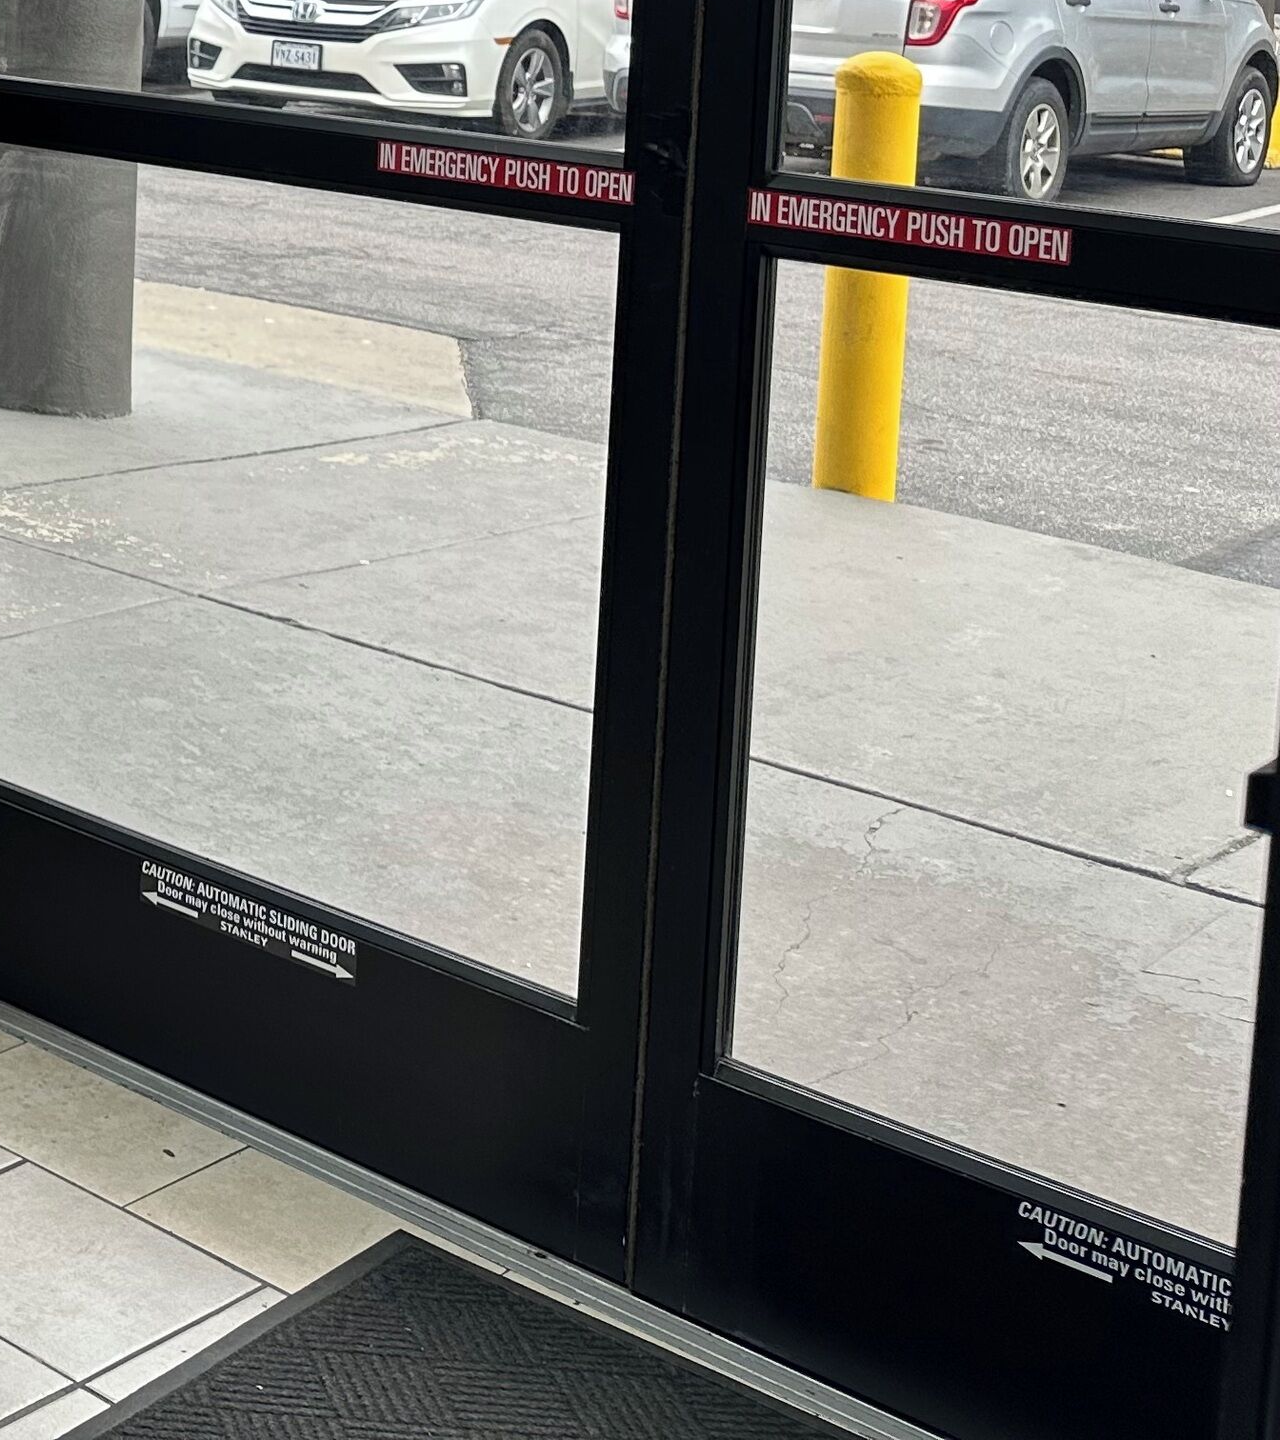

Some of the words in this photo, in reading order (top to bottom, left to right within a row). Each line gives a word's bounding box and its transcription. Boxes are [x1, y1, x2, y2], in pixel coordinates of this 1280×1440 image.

[379, 143, 397, 170] IN
[401, 147, 500, 183] EMERGENCY
[504, 160, 551, 192] PUSH
[557, 166, 580, 196] TO
[584, 170, 633, 203] OPEN
[750, 191, 772, 221] IN
[777, 196, 901, 238] EMERGENCY
[906, 211, 965, 248] PUSH
[972, 219, 1001, 252] TO
[1008, 224, 1070, 262] OPEN
[142, 860, 196, 892] CAUTION:
[196, 882, 268, 921] AUTOMATIC
[269, 910, 318, 941] SLIDING
[320, 929, 356, 956] DOOR
[157, 880, 184, 902] Door
[184, 893, 209, 913] may
[210, 900, 241, 923] close
[242, 914, 287, 943] without
[289, 934, 338, 964] warning
[220, 920, 269, 948] STANLEY
[1018, 1201, 1110, 1250] CAUTION:
[1111, 1237, 1233, 1297] AUTOMATIC
[1043, 1227, 1089, 1258] Door
[1091, 1249, 1130, 1278] may
[1134, 1265, 1186, 1297] close
[1151, 1290, 1232, 1333] STANLEY
